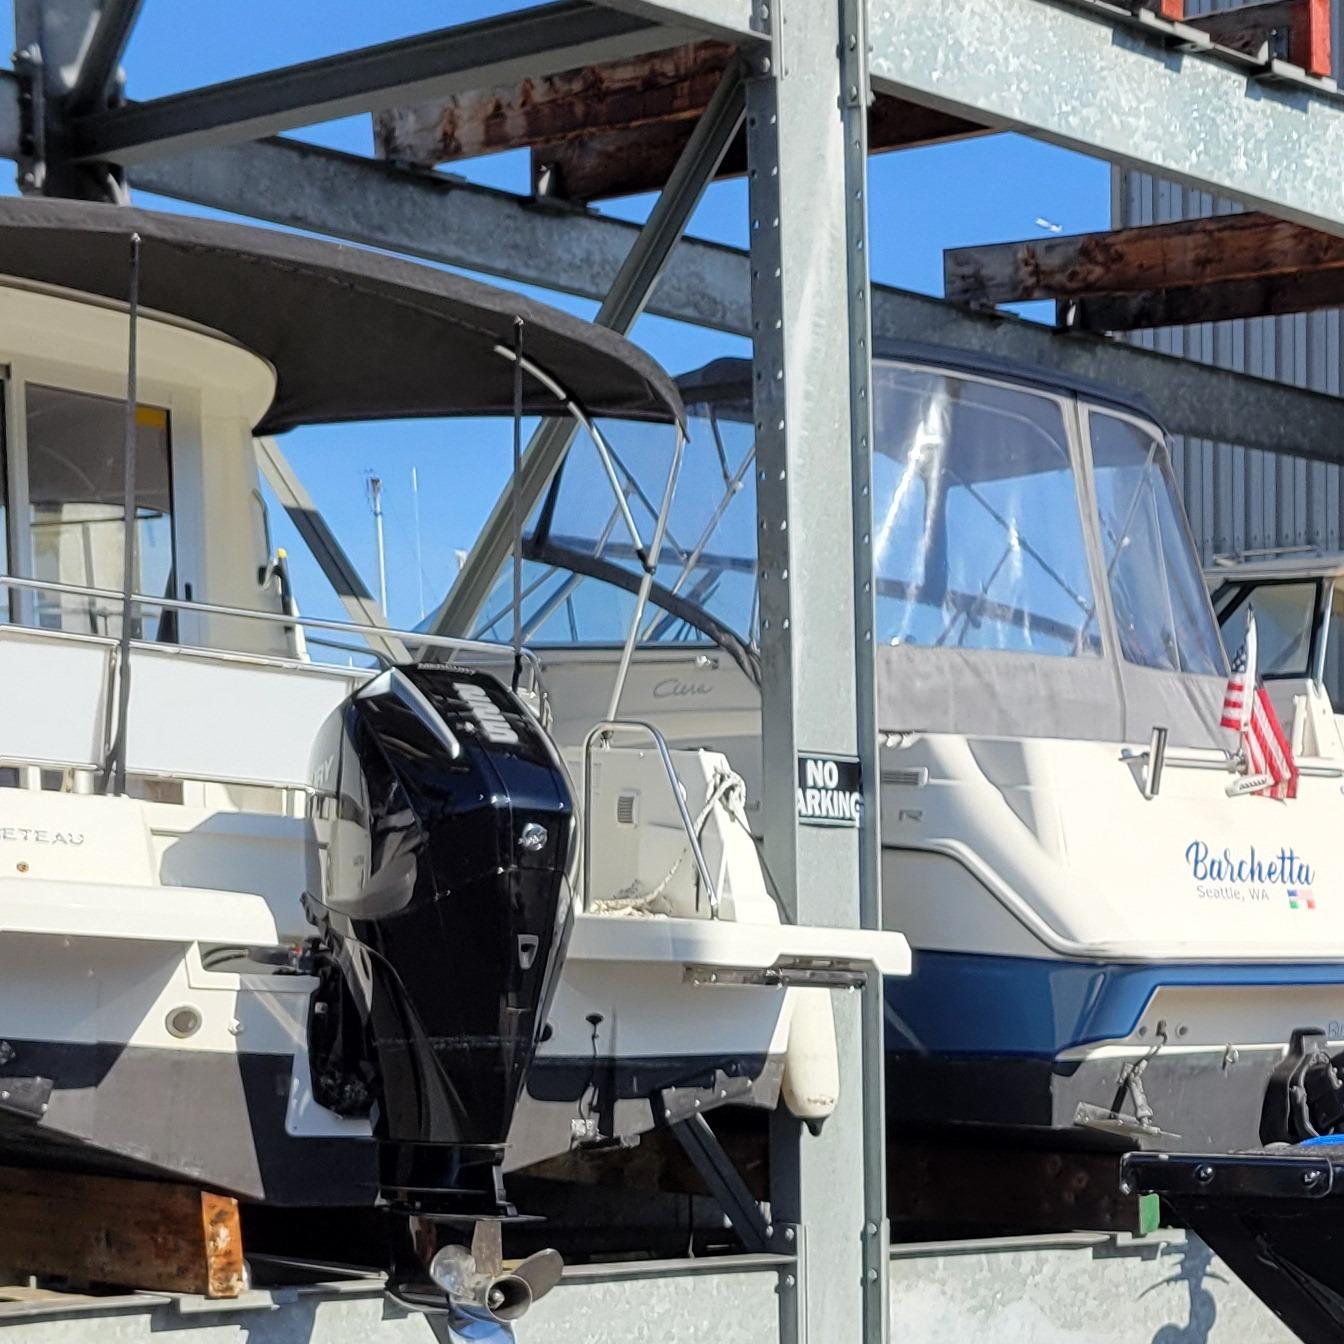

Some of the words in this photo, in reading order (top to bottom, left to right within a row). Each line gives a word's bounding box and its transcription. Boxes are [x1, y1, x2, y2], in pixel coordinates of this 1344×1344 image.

[805, 758, 840, 789] NO
[797, 787, 864, 828] ARKING
[0, 826, 84, 845] ETEAU
[1185, 839, 1316, 886] Barchetta
[1196, 885, 1246, 902] Seattle,
[1248, 887, 1270, 901] WA
